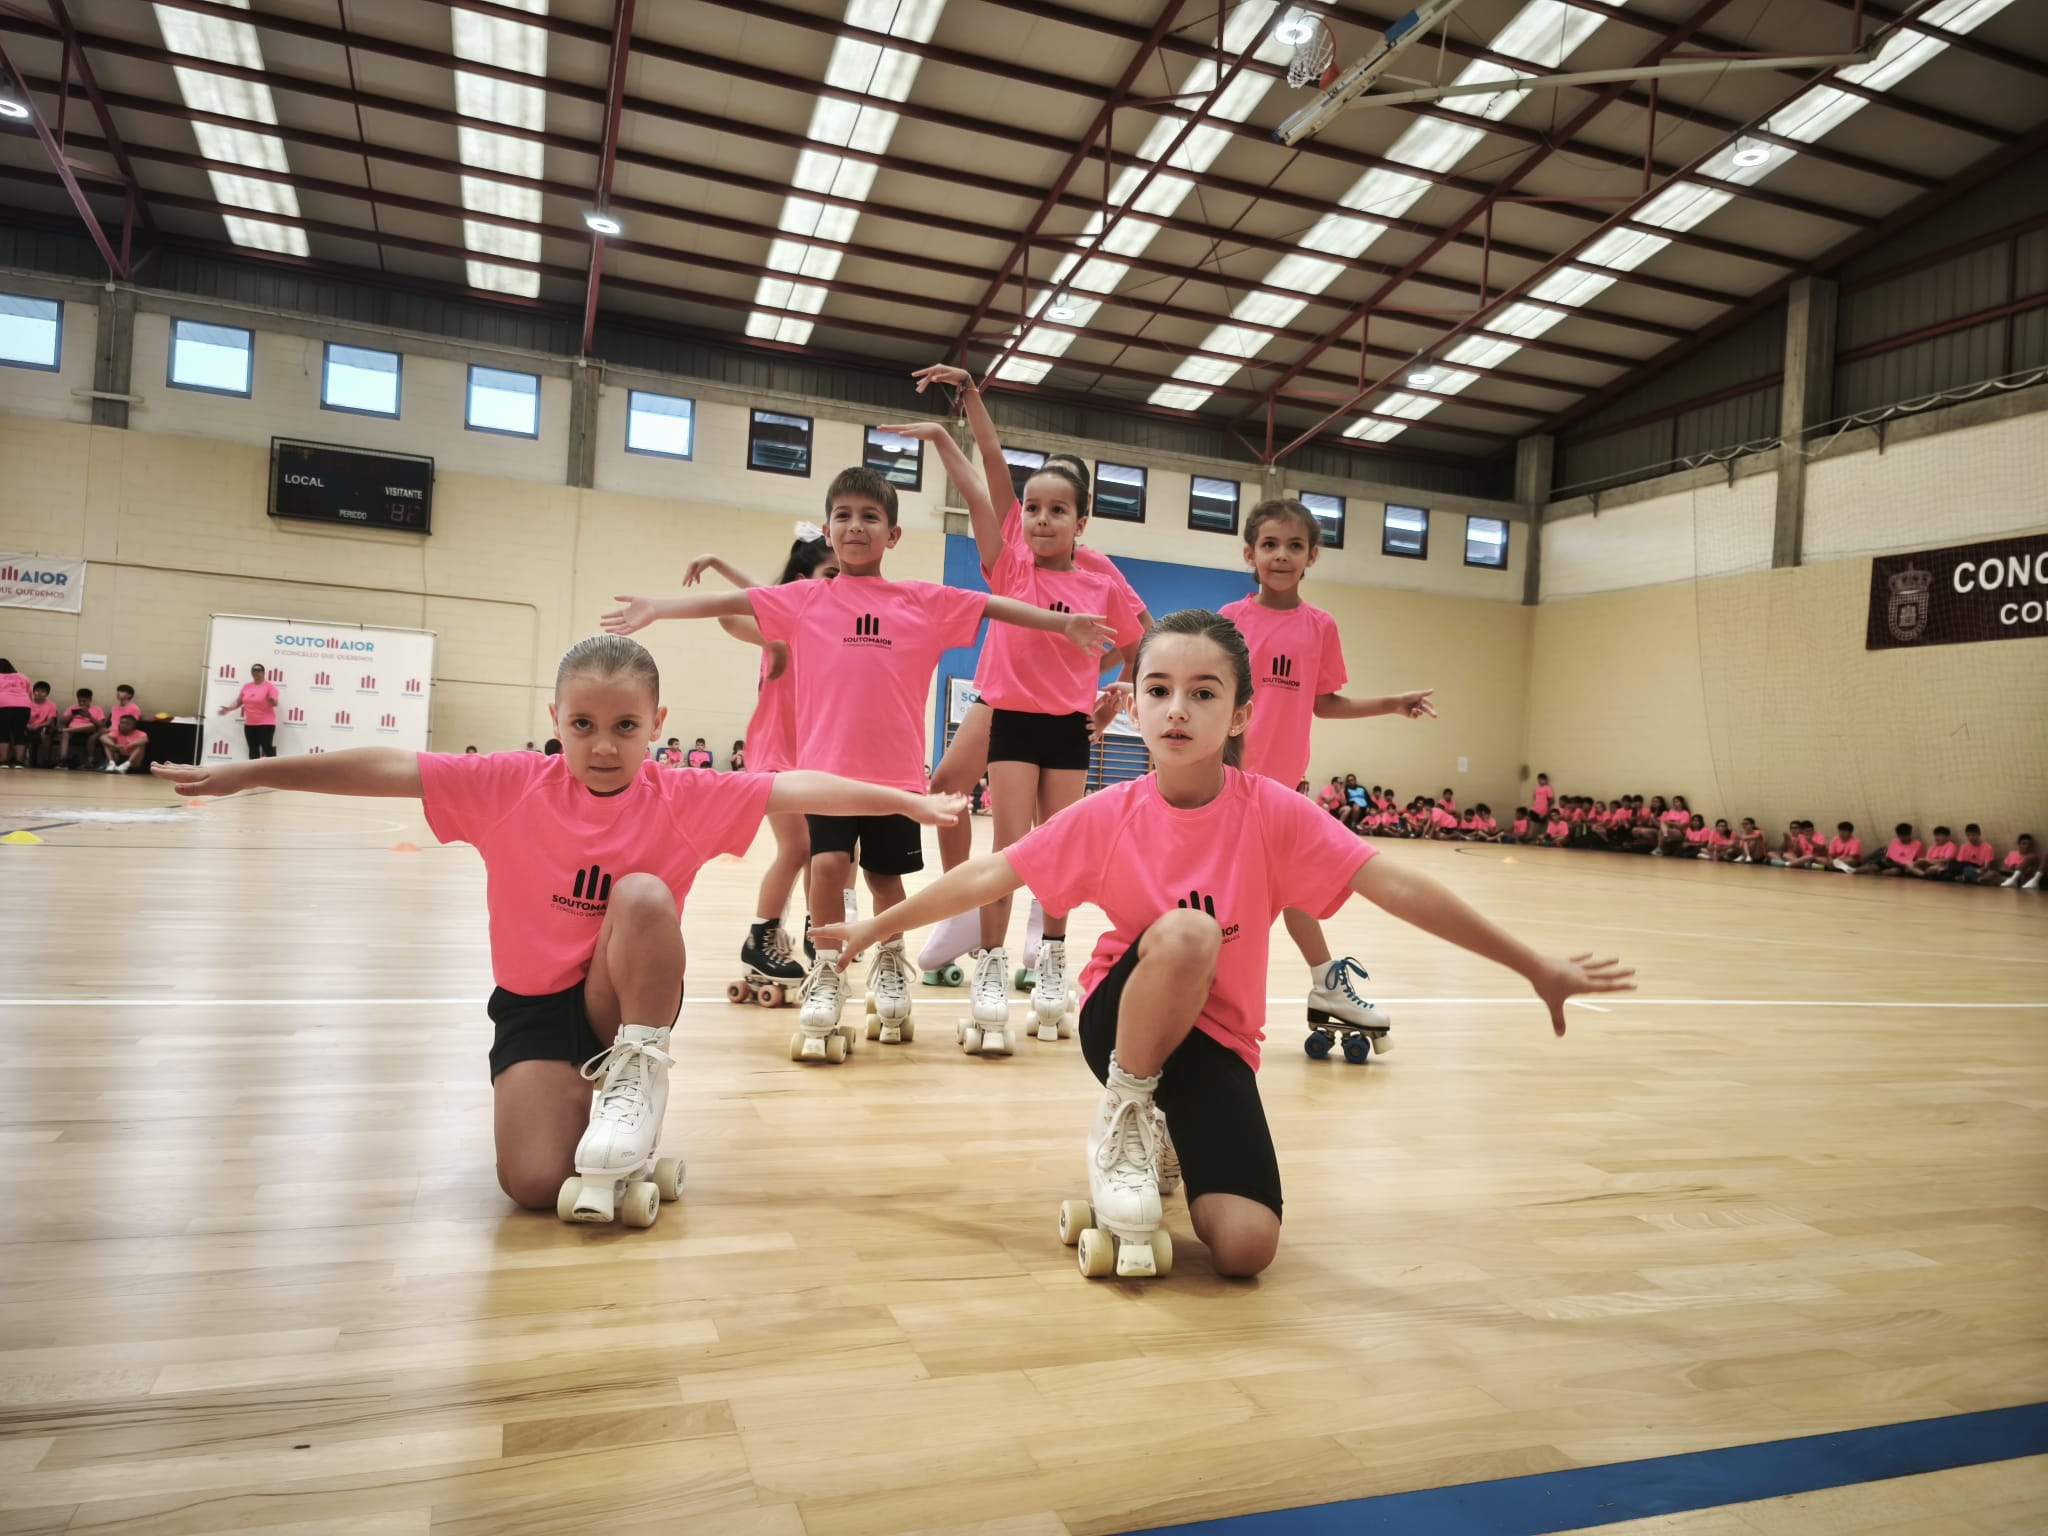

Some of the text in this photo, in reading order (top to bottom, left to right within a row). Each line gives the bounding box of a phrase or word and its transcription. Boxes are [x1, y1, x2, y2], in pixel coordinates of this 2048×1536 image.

[284, 473, 326, 488] LOCAL
[385, 486, 423, 500] VISITANTE
[338, 508, 368, 520] PERIODO
[15, 587, 65, 599] QUEREMOS
[2000, 600, 2048, 625] CO
[552, 894, 608, 912] SOUTOMA
